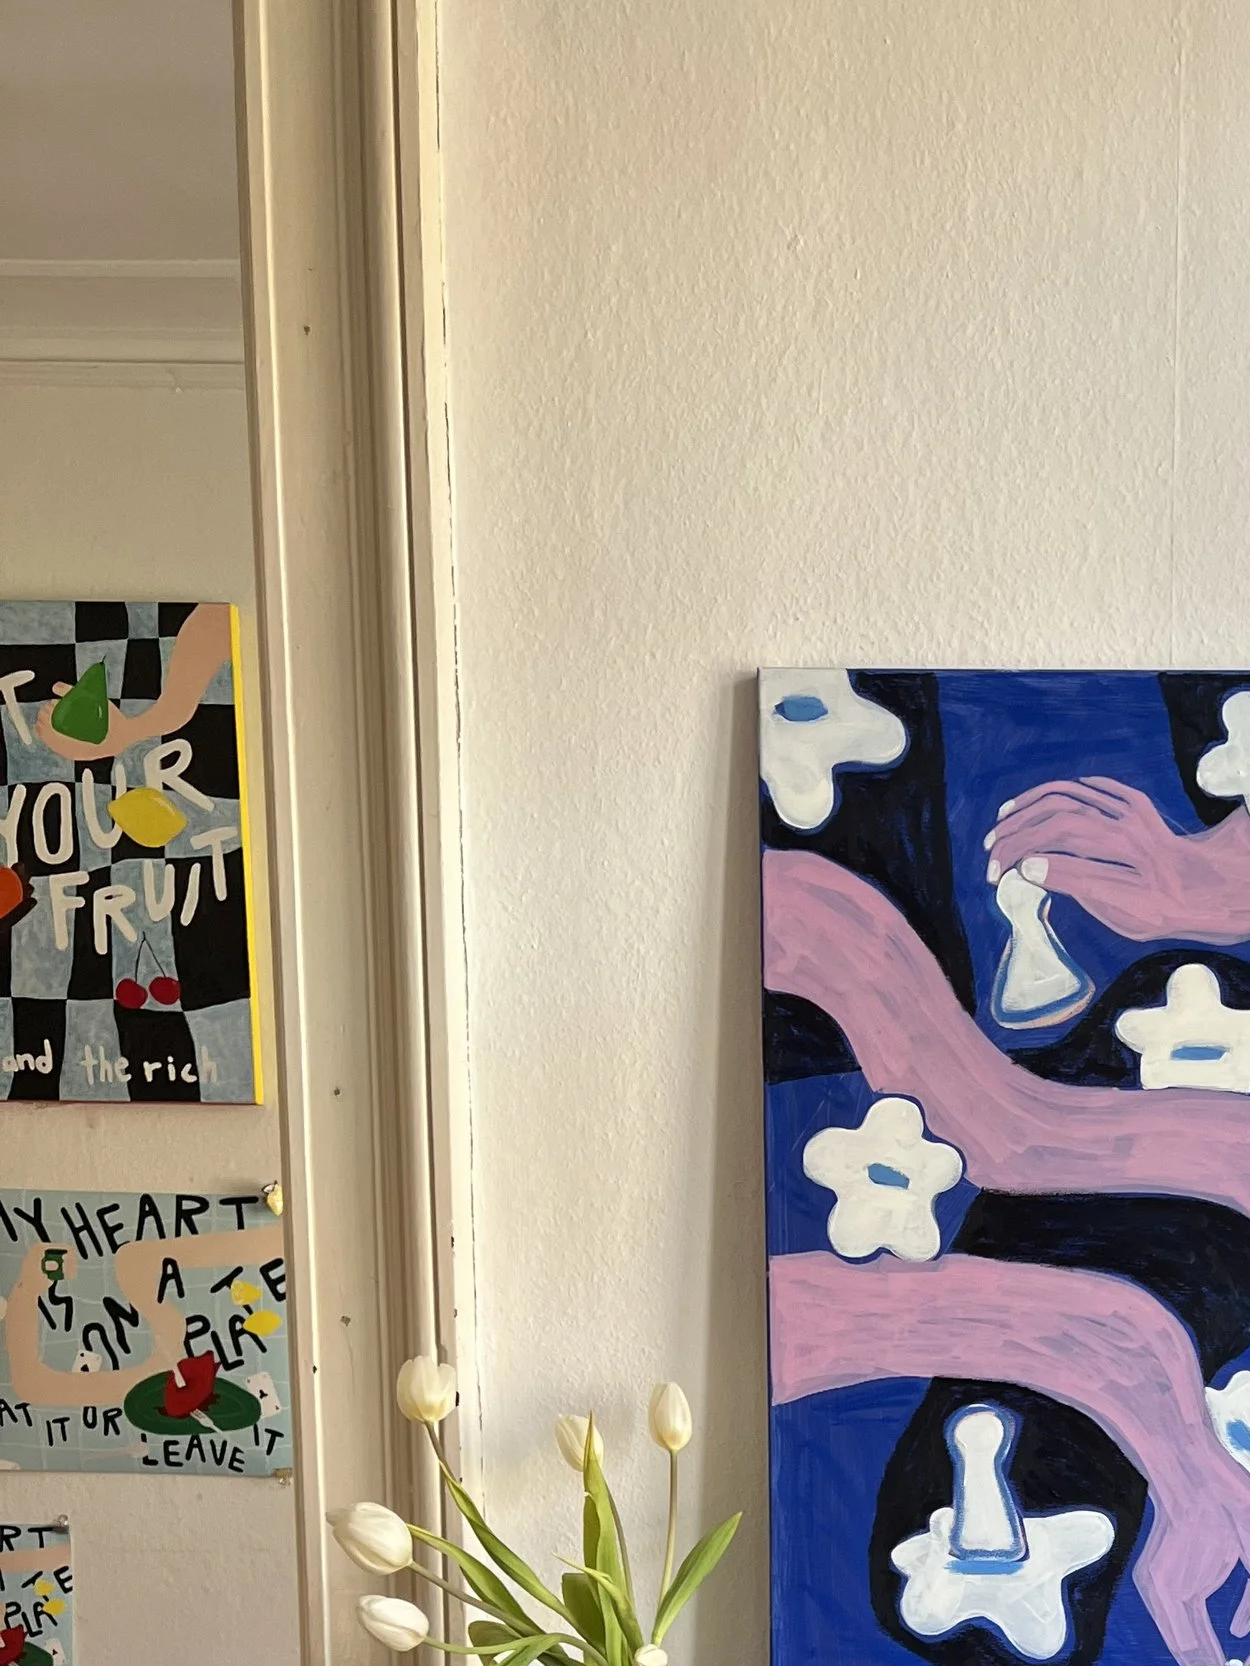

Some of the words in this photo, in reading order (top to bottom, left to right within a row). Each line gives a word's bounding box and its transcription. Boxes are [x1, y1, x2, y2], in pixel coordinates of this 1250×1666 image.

[49, 827, 238, 955] FRUIT
[1, 1039, 53, 1075] and
[80, 1044, 132, 1085] the
[143, 1046, 218, 1083] rich
[61, 1193, 259, 1260] HEART
[0, 1400, 32, 1427] AT
[46, 1416, 70, 1446] IT
[253, 1424, 284, 1455] IT
